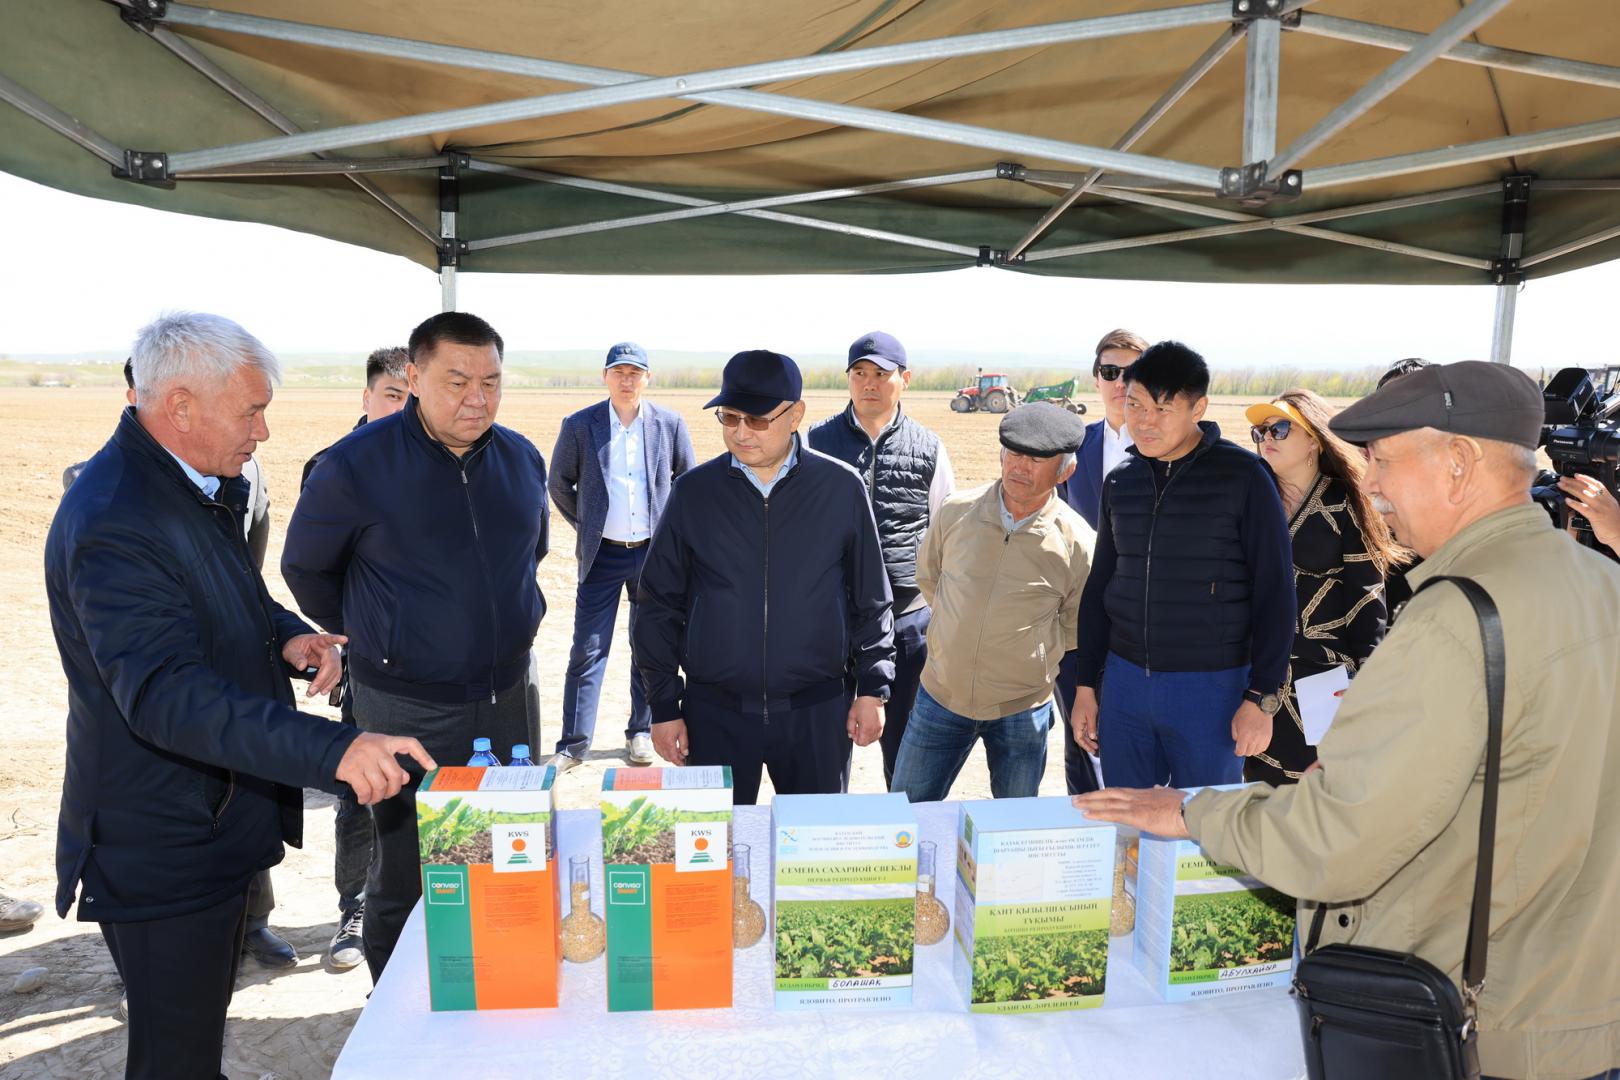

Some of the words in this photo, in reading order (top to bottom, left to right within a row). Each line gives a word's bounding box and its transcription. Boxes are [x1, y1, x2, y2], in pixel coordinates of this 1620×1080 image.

[690, 829, 712, 837] KWS
[781, 866, 820, 874] СЕМЕНА
[822, 864, 872, 873] САХАРНОЙ
